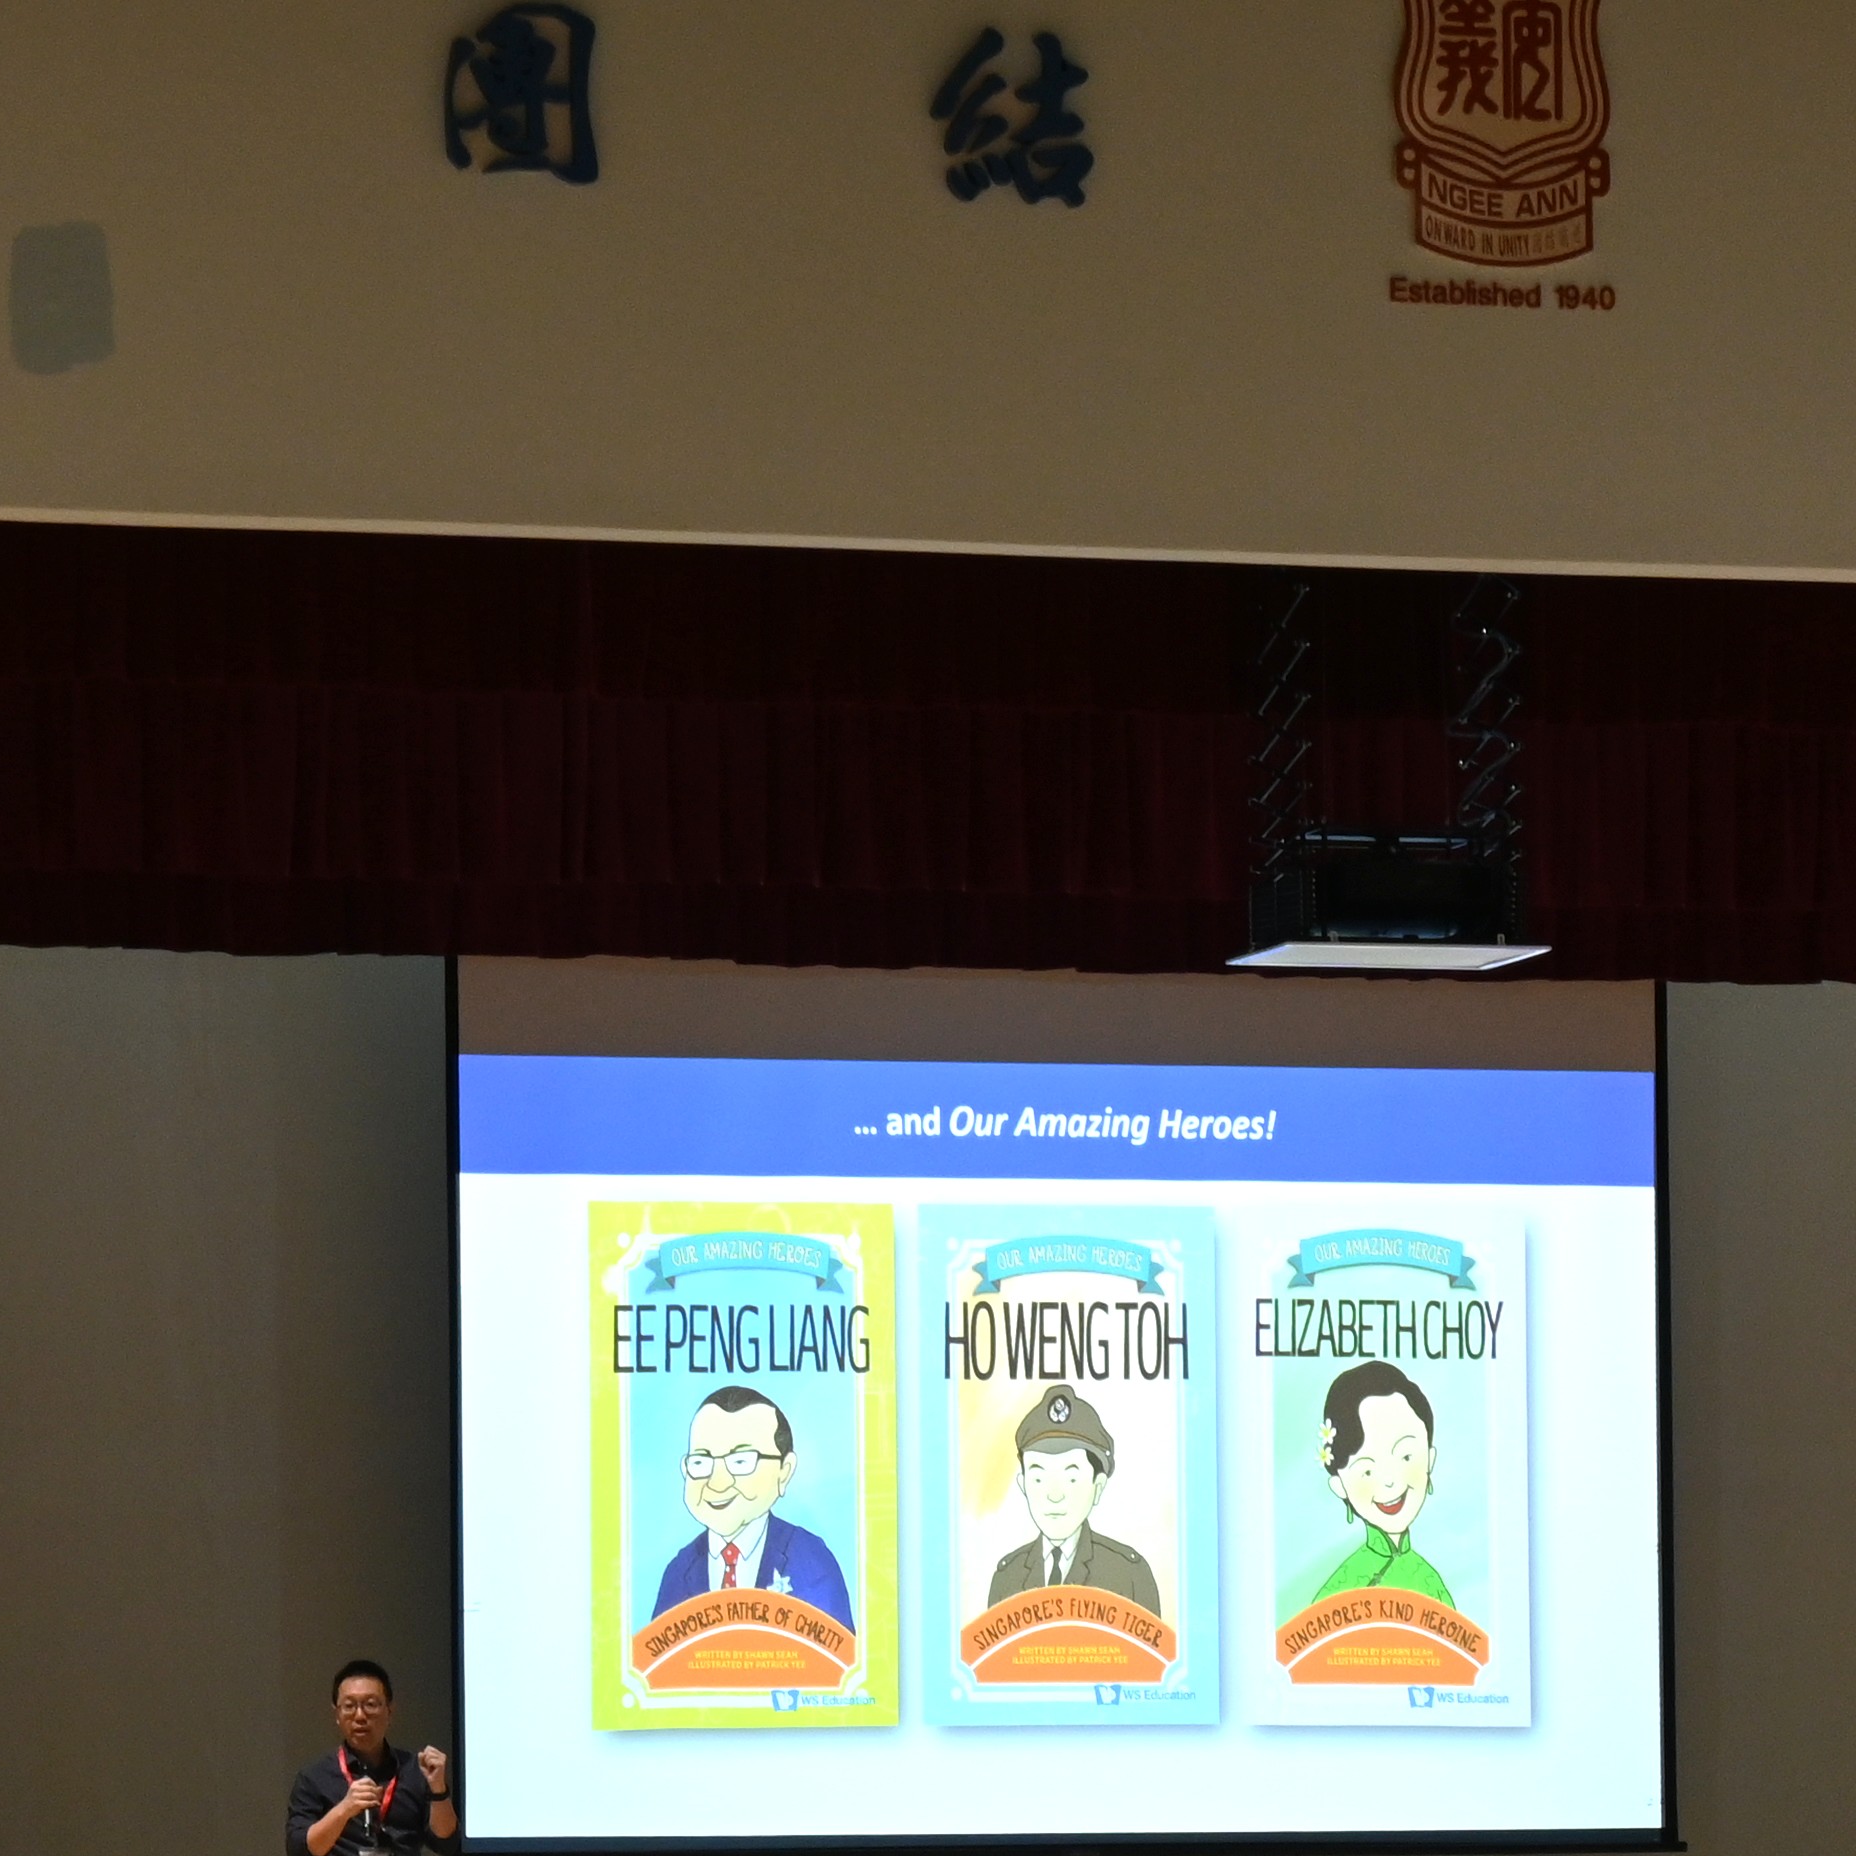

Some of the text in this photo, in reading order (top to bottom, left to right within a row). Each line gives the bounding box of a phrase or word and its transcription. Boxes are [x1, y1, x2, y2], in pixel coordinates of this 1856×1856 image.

[1428, 173, 1579, 217] NGEE ANN
[1482, 235, 1493, 254] IN
[1497, 235, 1530, 256] UNITY
[1390, 277, 1615, 310] Established 1940
[887, 1106, 941, 1136] and
[949, 1105, 1008, 1137] Our
[1014, 1106, 1150, 1146] Amazing
[1158, 1109, 1277, 1140] Heroes!
[671, 1240, 822, 1268] OUR AMAZING HEROES
[997, 1243, 1143, 1272] OUR AMAZING HEROES
[1314, 1237, 1451, 1266] OUR AMAZING HEROES
[613, 1304, 870, 1374] EE PENG LIANG
[944, 1301, 1189, 1381] HO WENG TOH
[1255, 1298, 1504, 1360] ELIZABETH CHOY
[645, 1601, 845, 1658] SINGAPORE'S FATHER OF CHARITY
[973, 1597, 1163, 1651] SINGAPORE'S FLYING TIGER
[1284, 1600, 1481, 1655] SINGAPORE'S KIND HEROINE
[801, 1695, 876, 1706] WS Education
[1123, 1689, 1196, 1701] WS Education
[1436, 1692, 1509, 1704] WS Education
